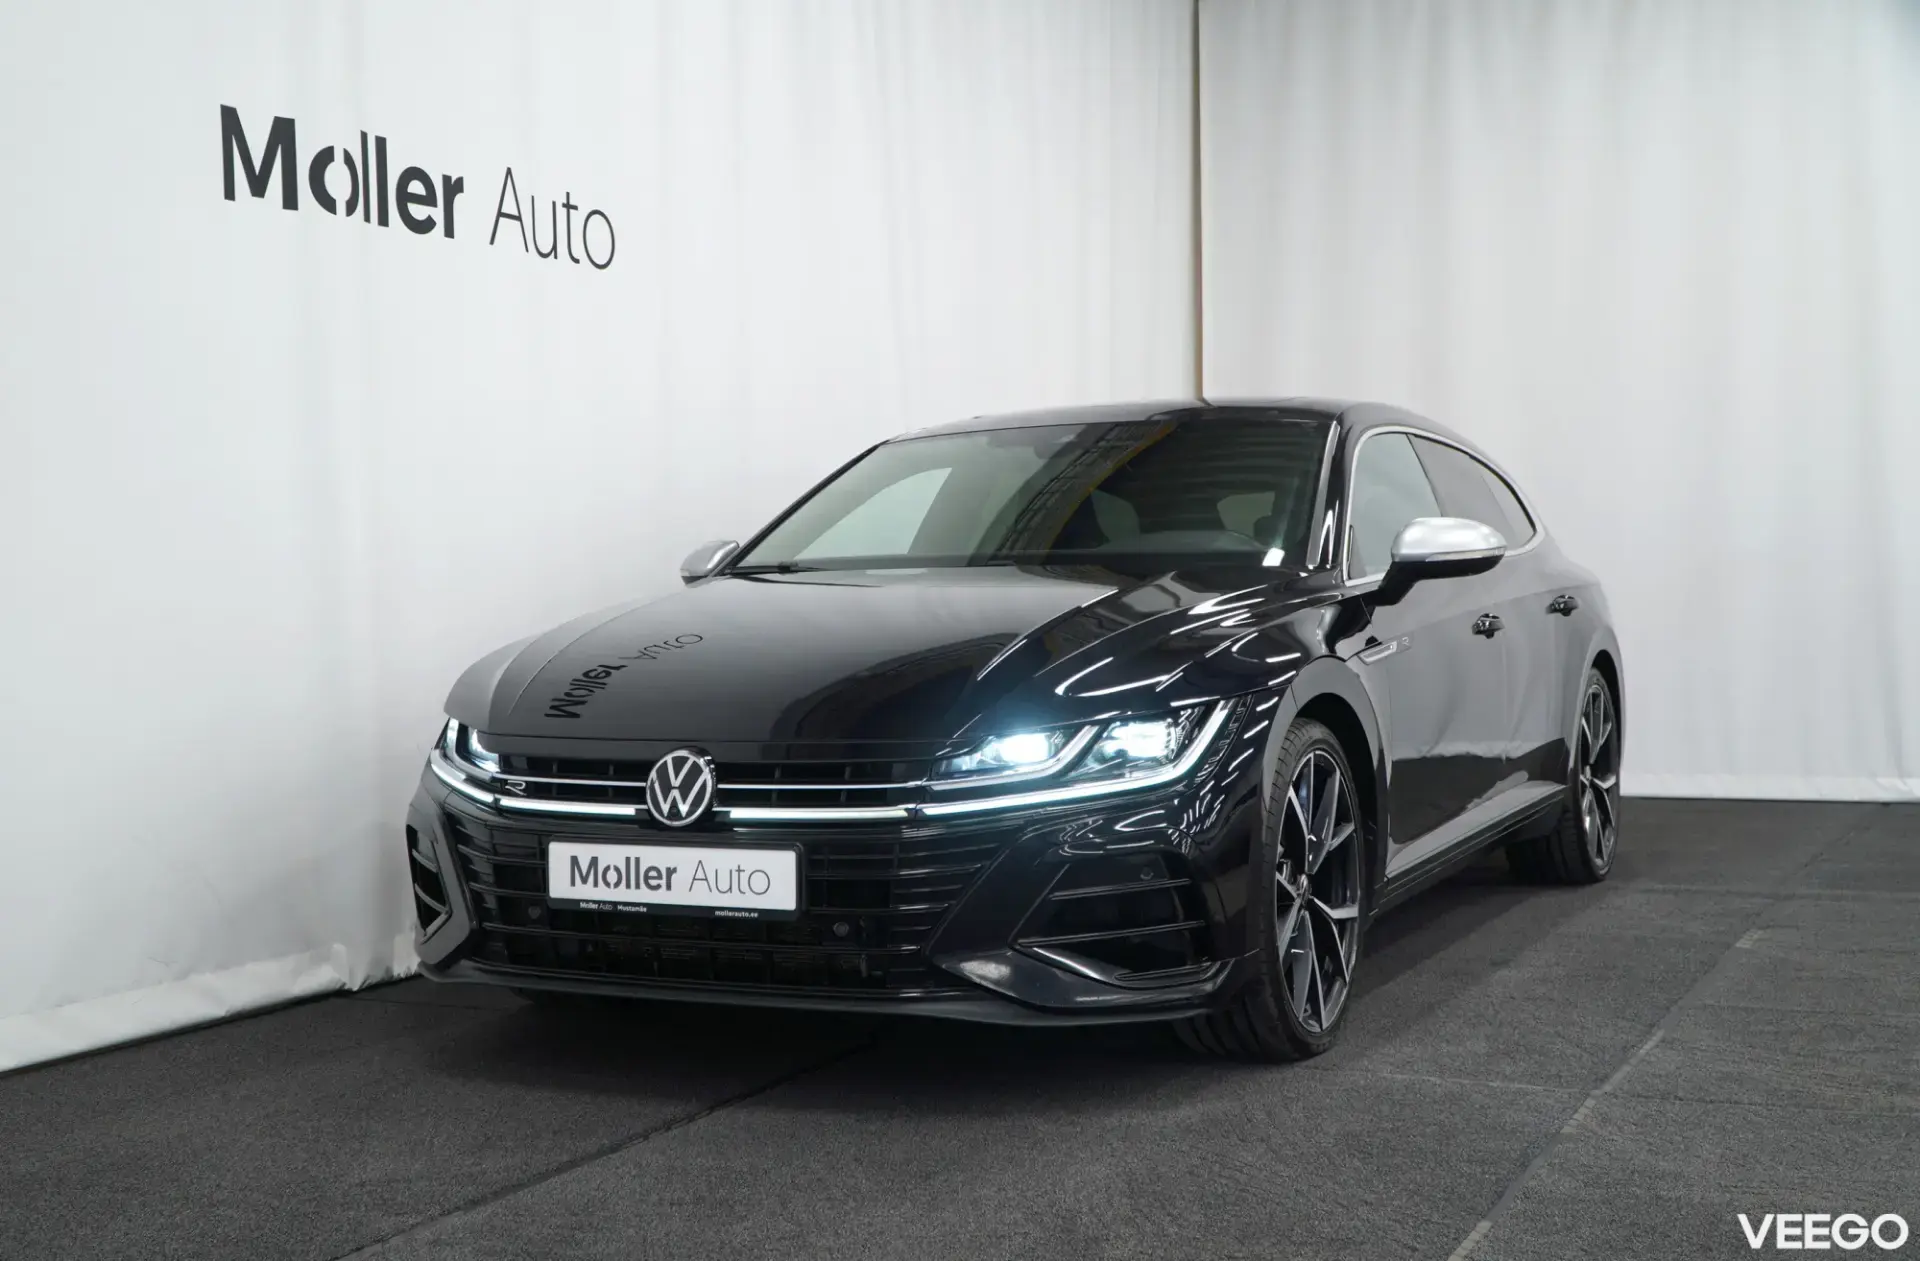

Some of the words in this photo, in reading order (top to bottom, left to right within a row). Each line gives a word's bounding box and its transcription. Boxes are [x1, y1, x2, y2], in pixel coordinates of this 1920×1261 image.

[489, 167, 616, 270] Auto
[688, 859, 771, 896] Auto
[599, 903, 613, 911] Auto
[714, 909, 759, 919] mollerauto.ee
